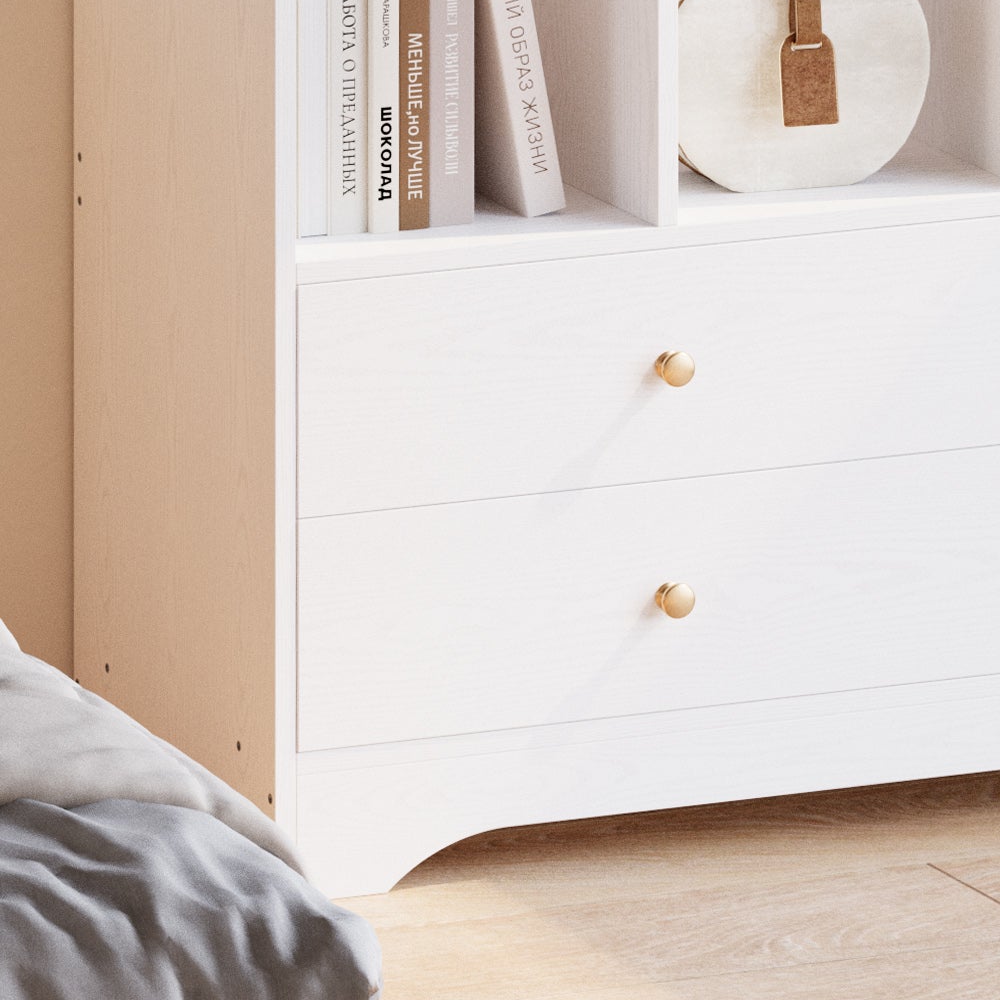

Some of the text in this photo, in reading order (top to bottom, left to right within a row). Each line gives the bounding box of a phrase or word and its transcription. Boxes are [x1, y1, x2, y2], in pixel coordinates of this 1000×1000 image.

[342, 58, 356, 73] О
[509, 25, 534, 92] ОБРАЗ
[340, 77, 356, 197] ПРЕДАННЫХ
[378, 106, 392, 202] ШОКОЛАД
[407, 138, 424, 201] ЛУЧШЕ
[521, 96, 549, 175] ЖИЗНИ
